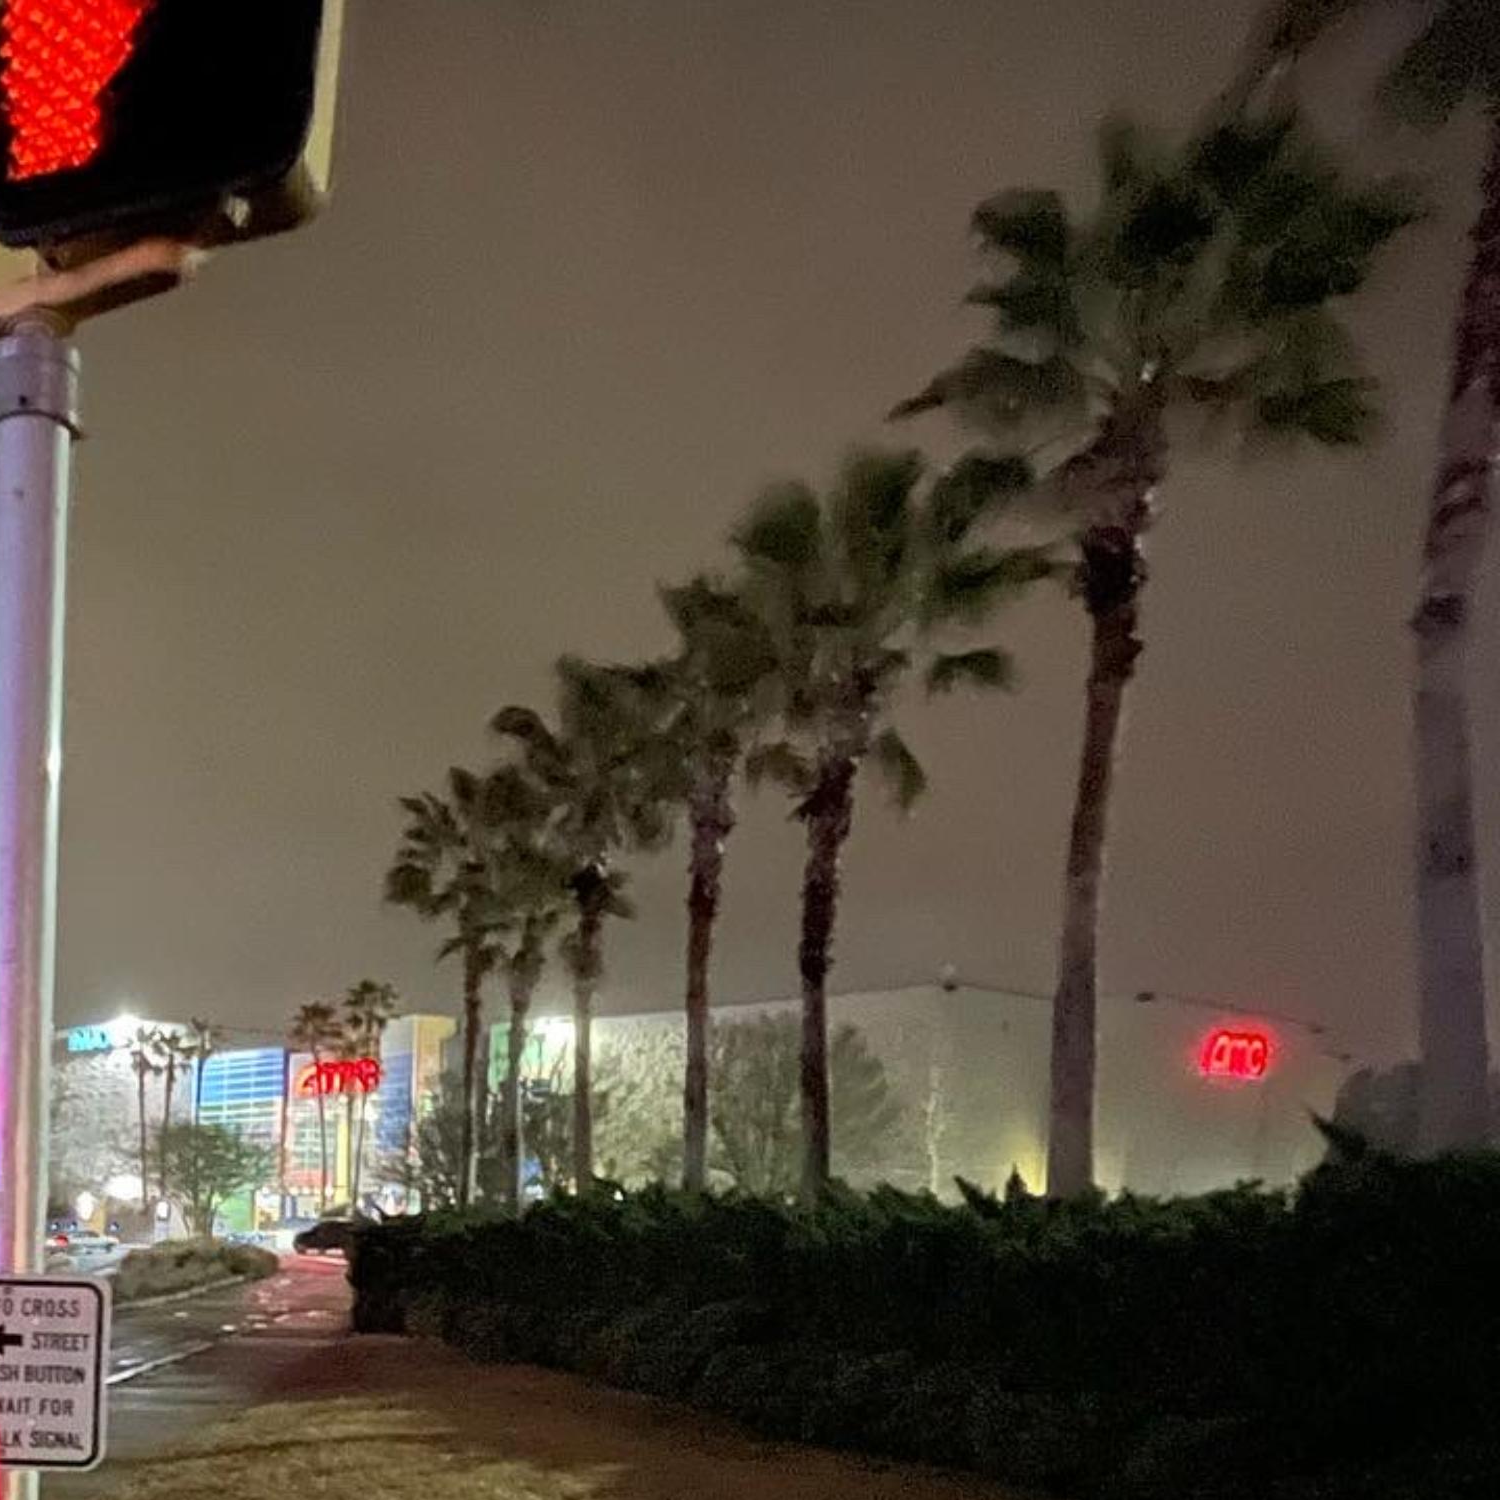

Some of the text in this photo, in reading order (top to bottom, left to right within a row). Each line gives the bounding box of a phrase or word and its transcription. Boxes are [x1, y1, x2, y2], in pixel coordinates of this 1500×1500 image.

[21, 1298, 80, 1318] CROSS
[31, 1332, 90, 1351] STREET
[24, 1365, 85, 1384] BUTTON
[39, 1398, 74, 1416] FOR
[29, 1431, 84, 1450] SIGNAL
